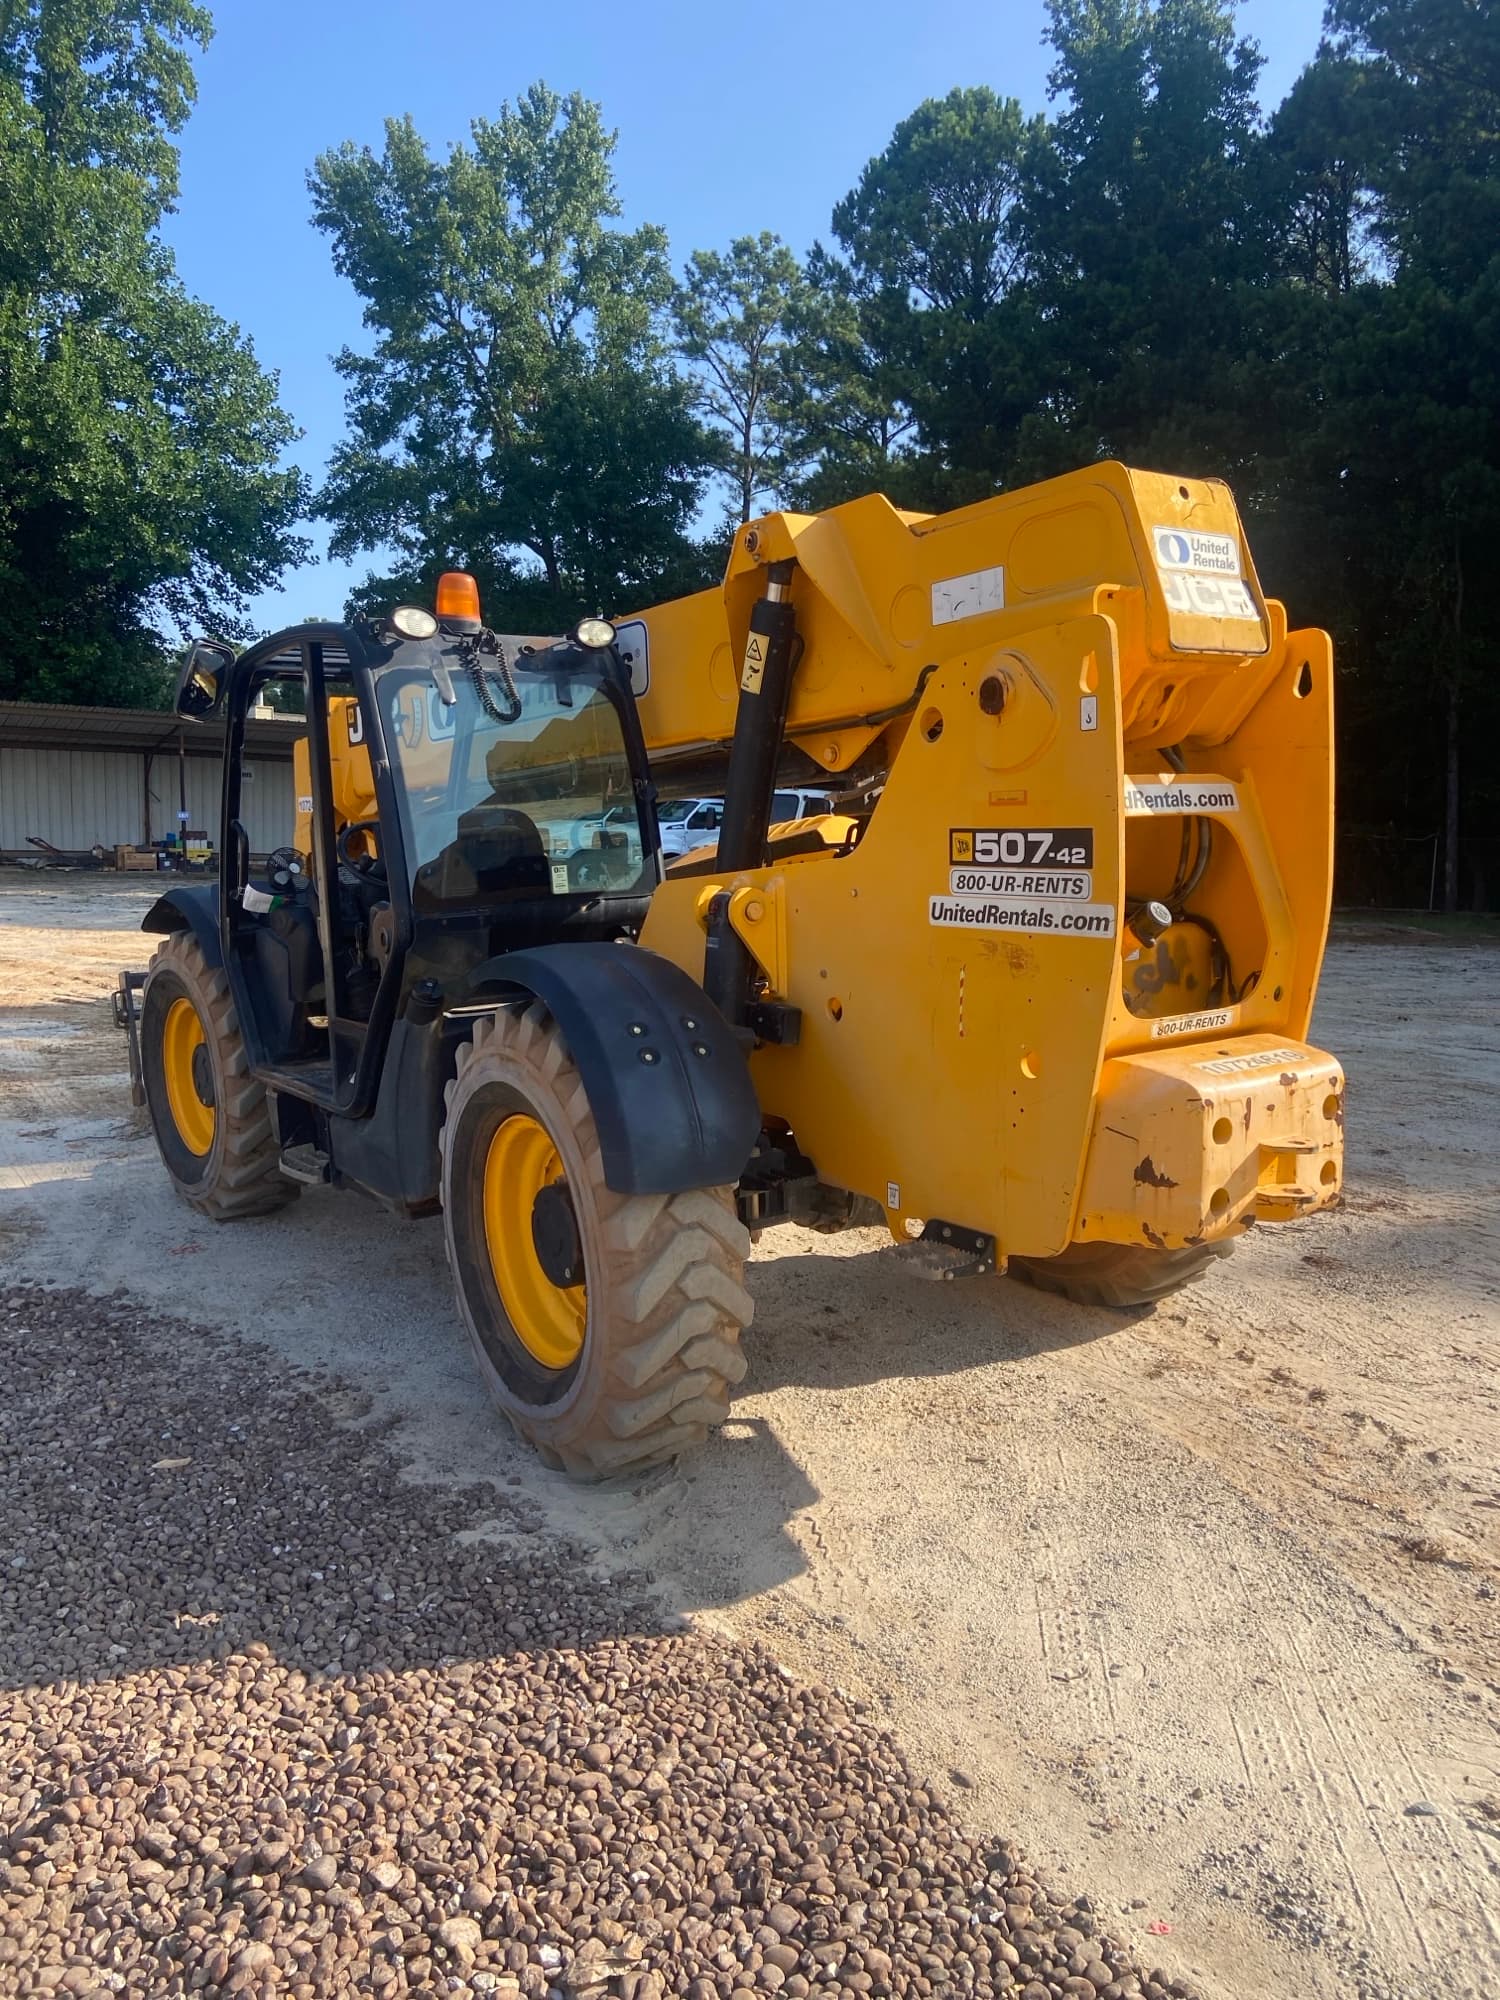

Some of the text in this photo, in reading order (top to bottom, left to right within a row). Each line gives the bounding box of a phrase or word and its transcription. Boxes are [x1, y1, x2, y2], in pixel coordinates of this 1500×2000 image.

[1190, 538, 1229, 556] United
[1193, 553, 1236, 571] Rentals
[974, 832, 1086, 864] 507-42
[956, 874, 1084, 895] 800-UR-RENTS
[930, 902, 1110, 932] UnitedRentals.com
[1157, 1014, 1227, 1036] 800-UR-RENTS
